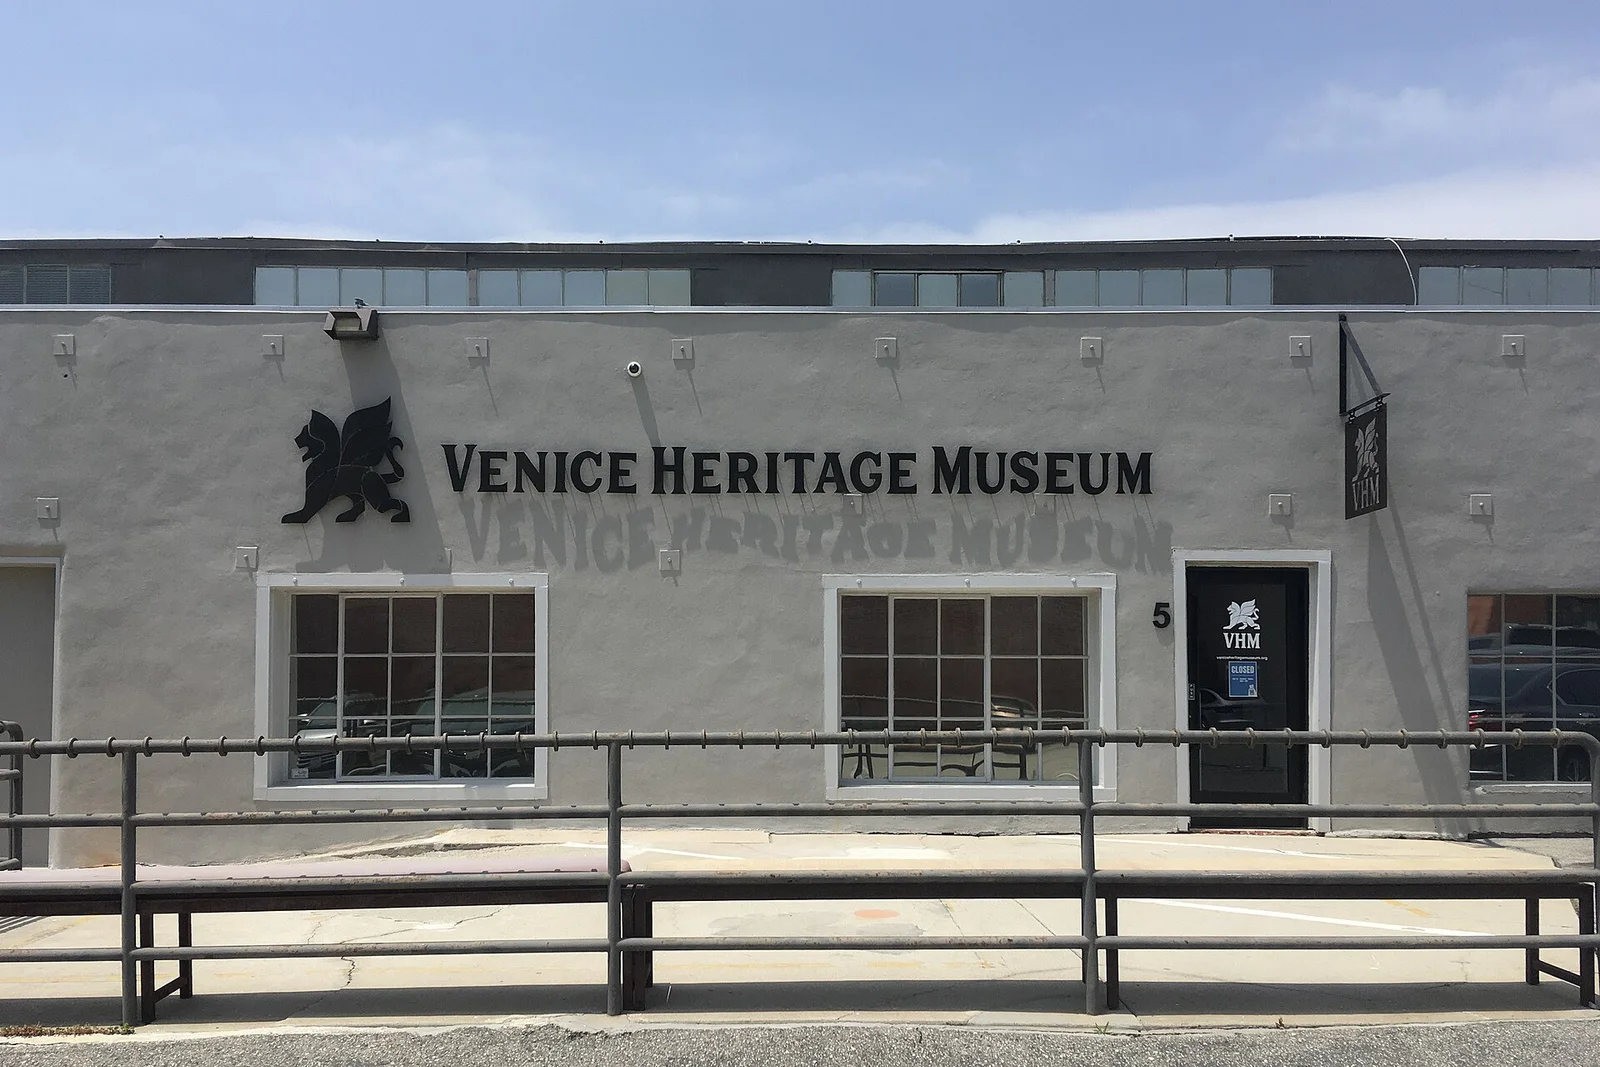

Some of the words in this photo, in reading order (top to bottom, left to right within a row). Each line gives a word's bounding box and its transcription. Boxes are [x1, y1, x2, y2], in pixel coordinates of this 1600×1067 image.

[441, 444, 638, 496] VENICE
[650, 446, 918, 497] HERITAGE
[930, 445, 1153, 496] MUSEUM
[1352, 474, 1380, 510] VHM
[1153, 602, 1171, 628] 5
[1223, 632, 1261, 649] VHM
[1231, 665, 1255, 674] CLOSED
